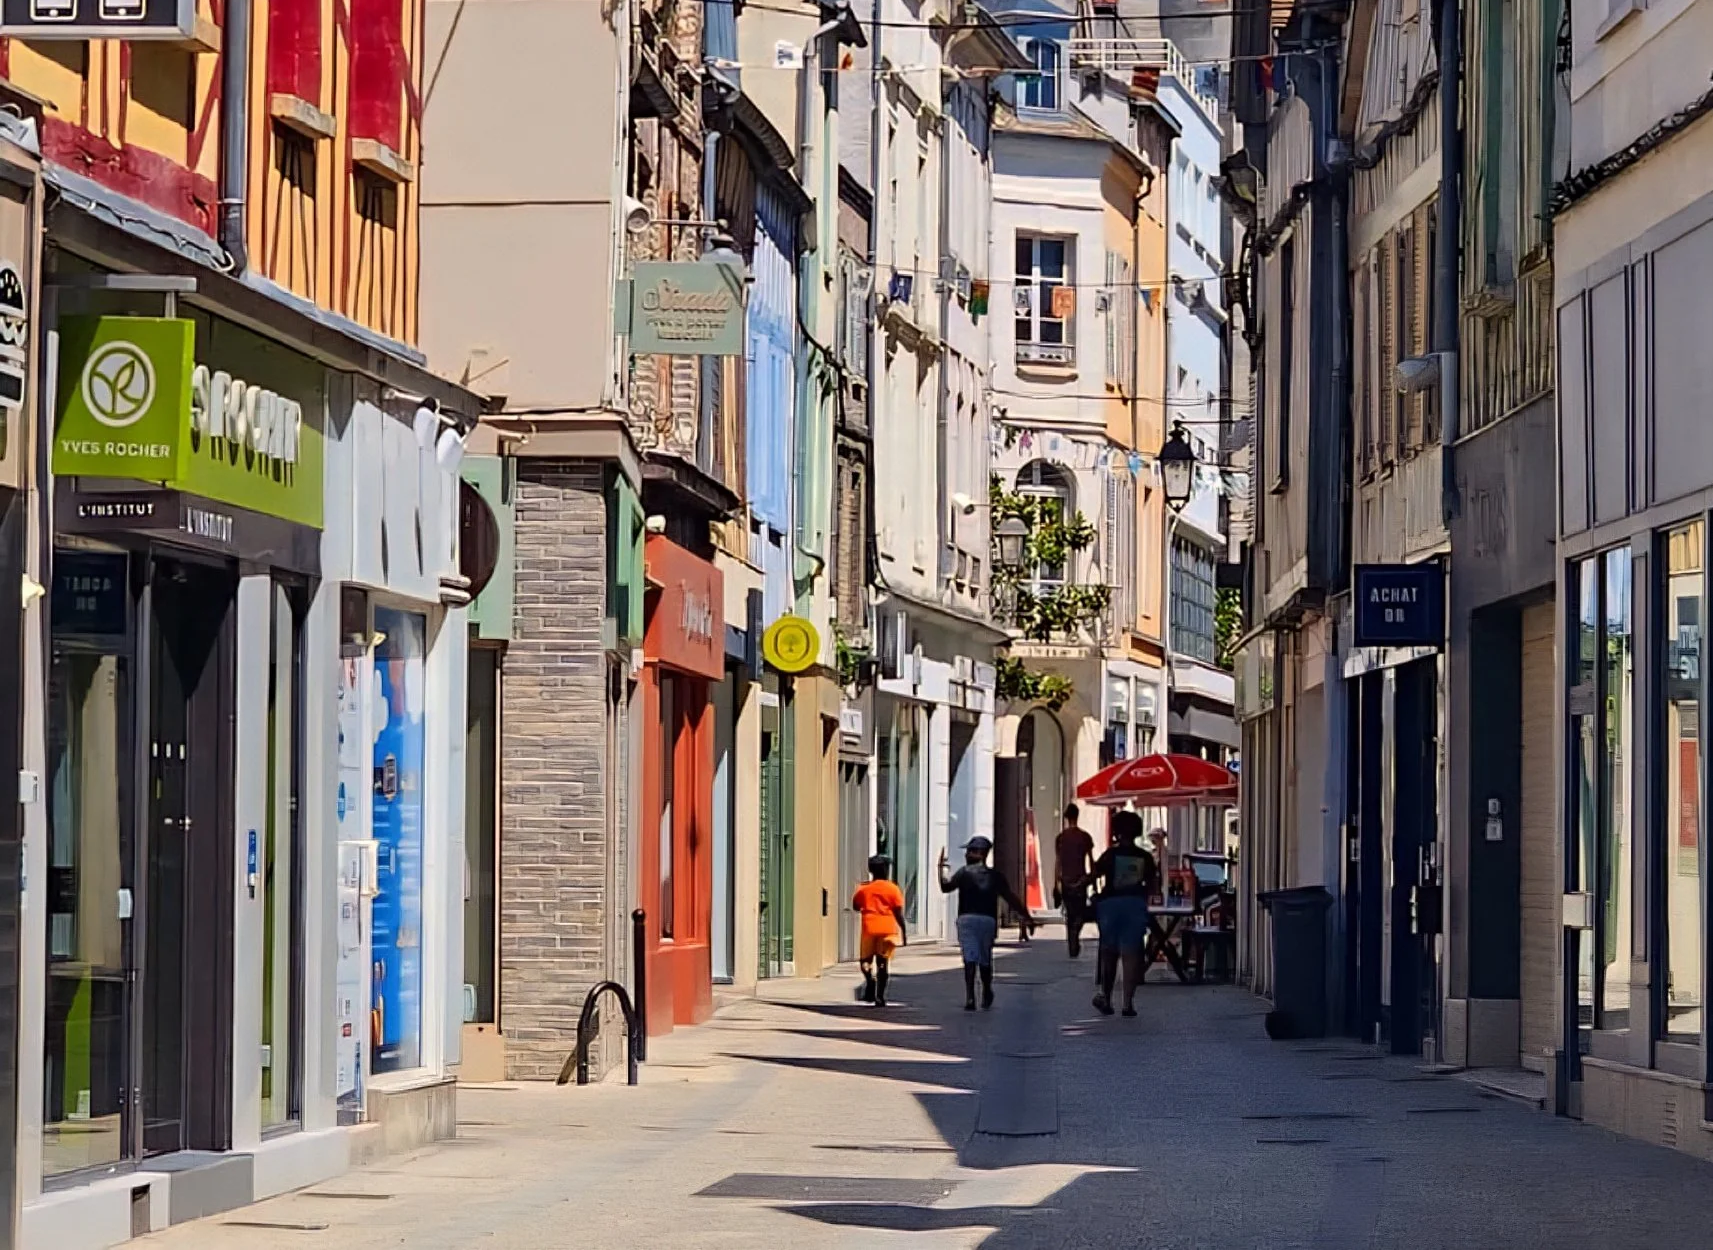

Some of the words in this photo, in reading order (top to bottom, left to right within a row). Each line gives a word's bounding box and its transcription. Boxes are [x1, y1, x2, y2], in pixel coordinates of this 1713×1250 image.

[61, 440, 100, 455] YVES
[105, 442, 170, 458] ROCHER
[79, 503, 155, 517] L'INSTITUT
[1370, 587, 1418, 602] ACHAT
